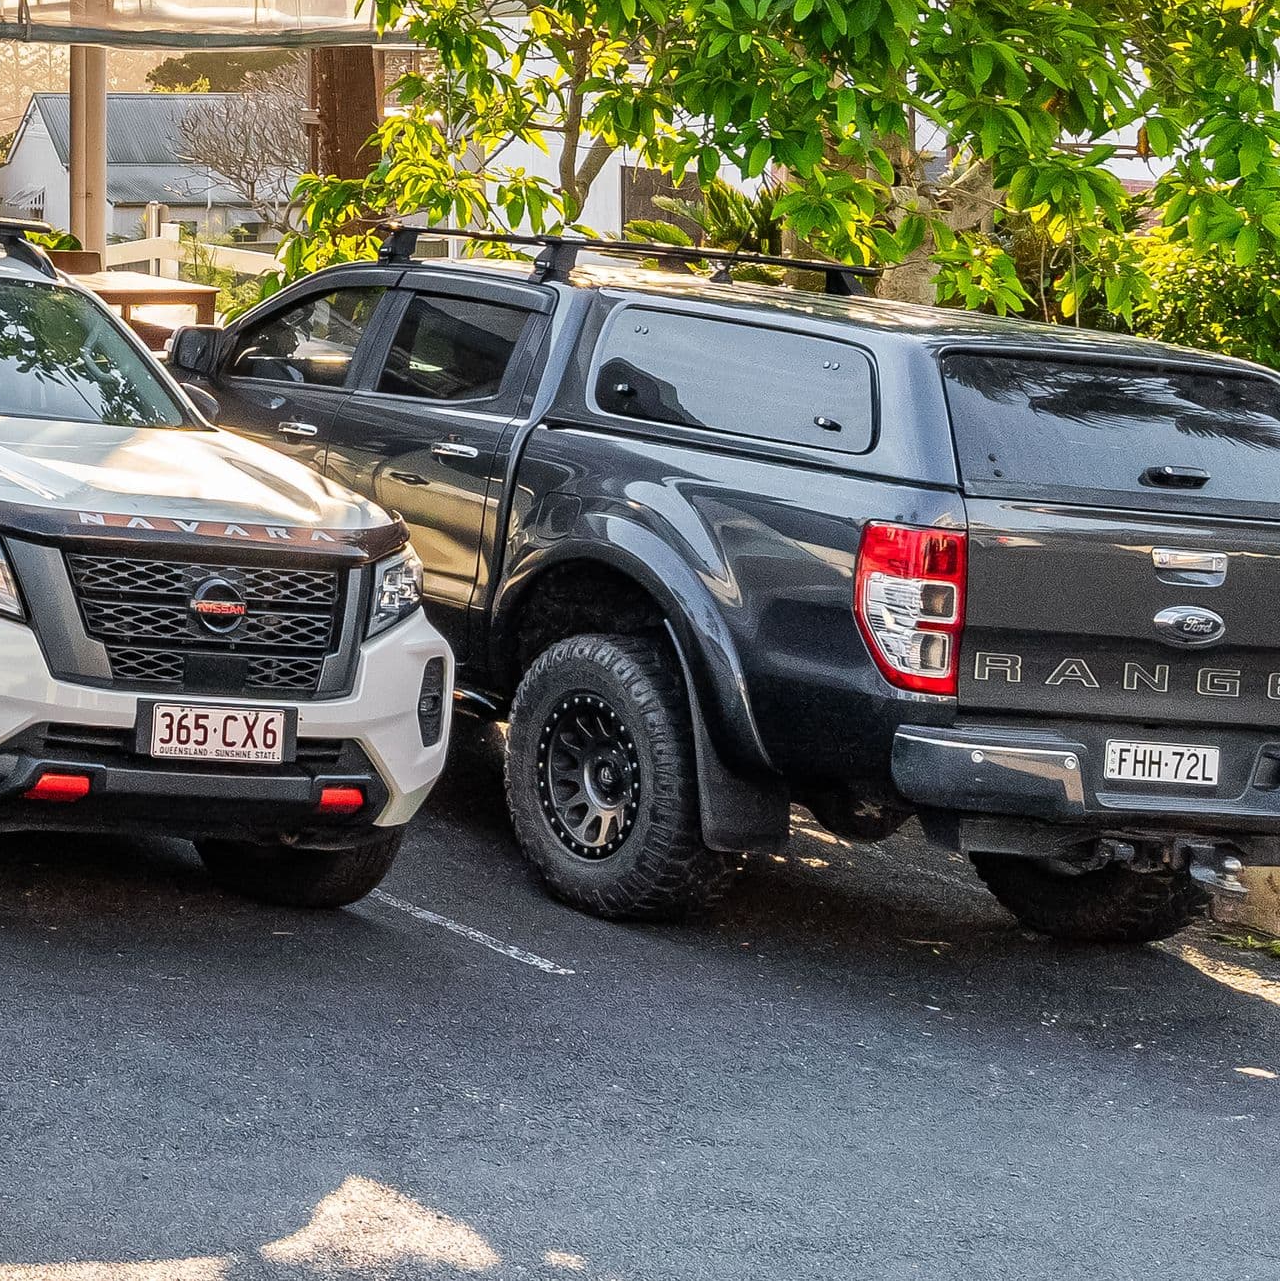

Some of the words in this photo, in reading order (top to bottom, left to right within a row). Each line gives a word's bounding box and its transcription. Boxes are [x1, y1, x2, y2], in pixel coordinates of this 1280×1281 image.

[77, 511, 337, 543] NAVARA
[194, 602, 246, 615] NISSAN
[1182, 616, 1213, 633] Ford
[159, 746, 208, 757] QUEENSLAND
[214, 748, 252, 759] SUNSHINE
[254, 751, 277, 760] STATE
